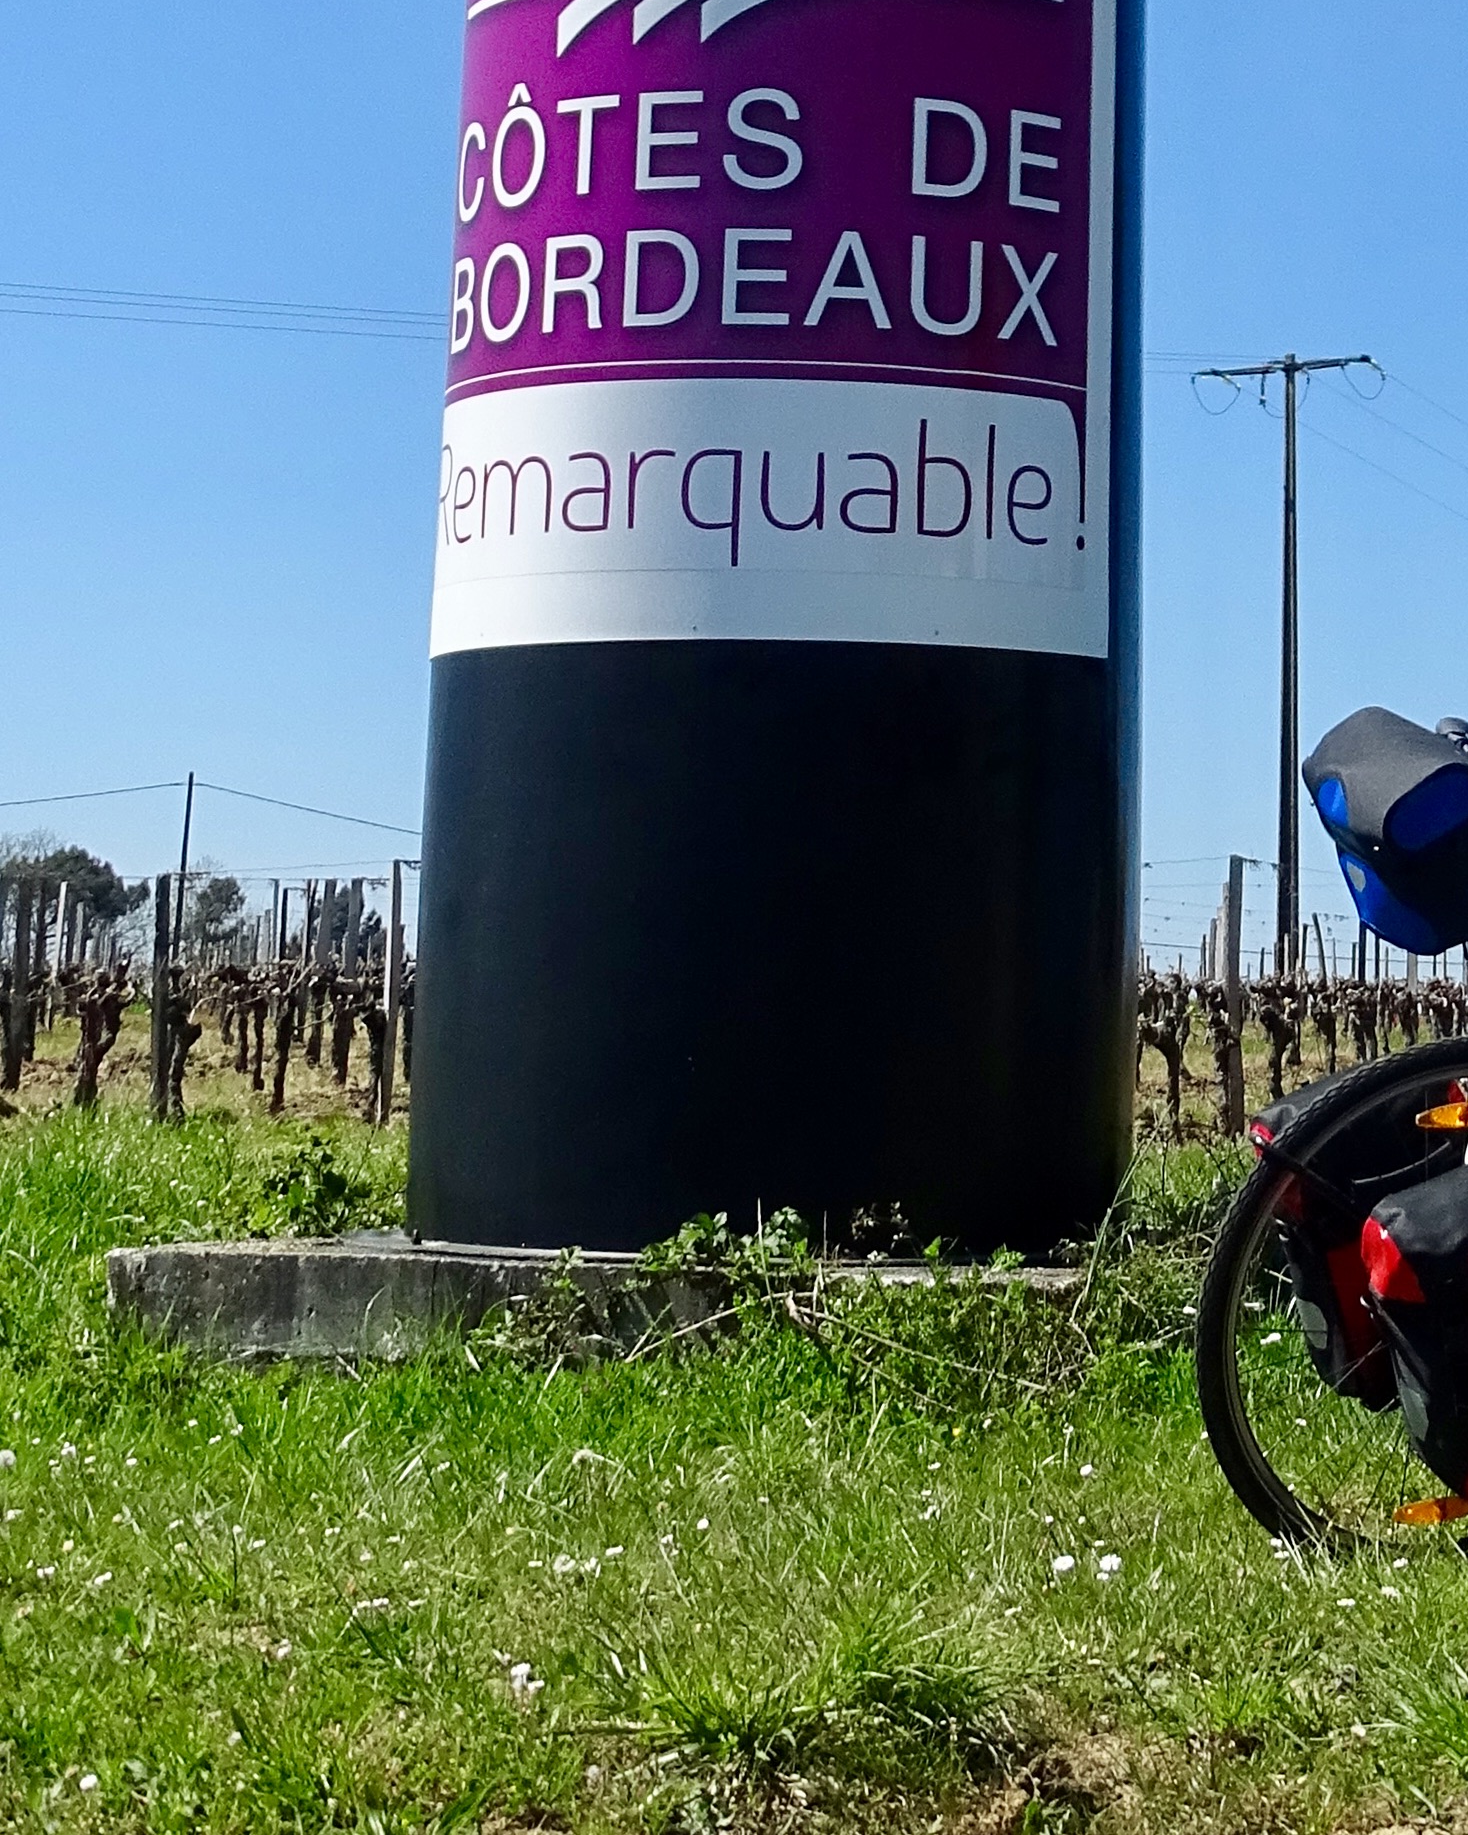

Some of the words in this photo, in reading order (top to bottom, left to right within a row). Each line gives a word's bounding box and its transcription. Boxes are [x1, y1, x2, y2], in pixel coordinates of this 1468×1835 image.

[458, 82, 803, 224] CÔTES
[911, 96, 1061, 214] DE
[451, 228, 1060, 356] BORDEAUX
